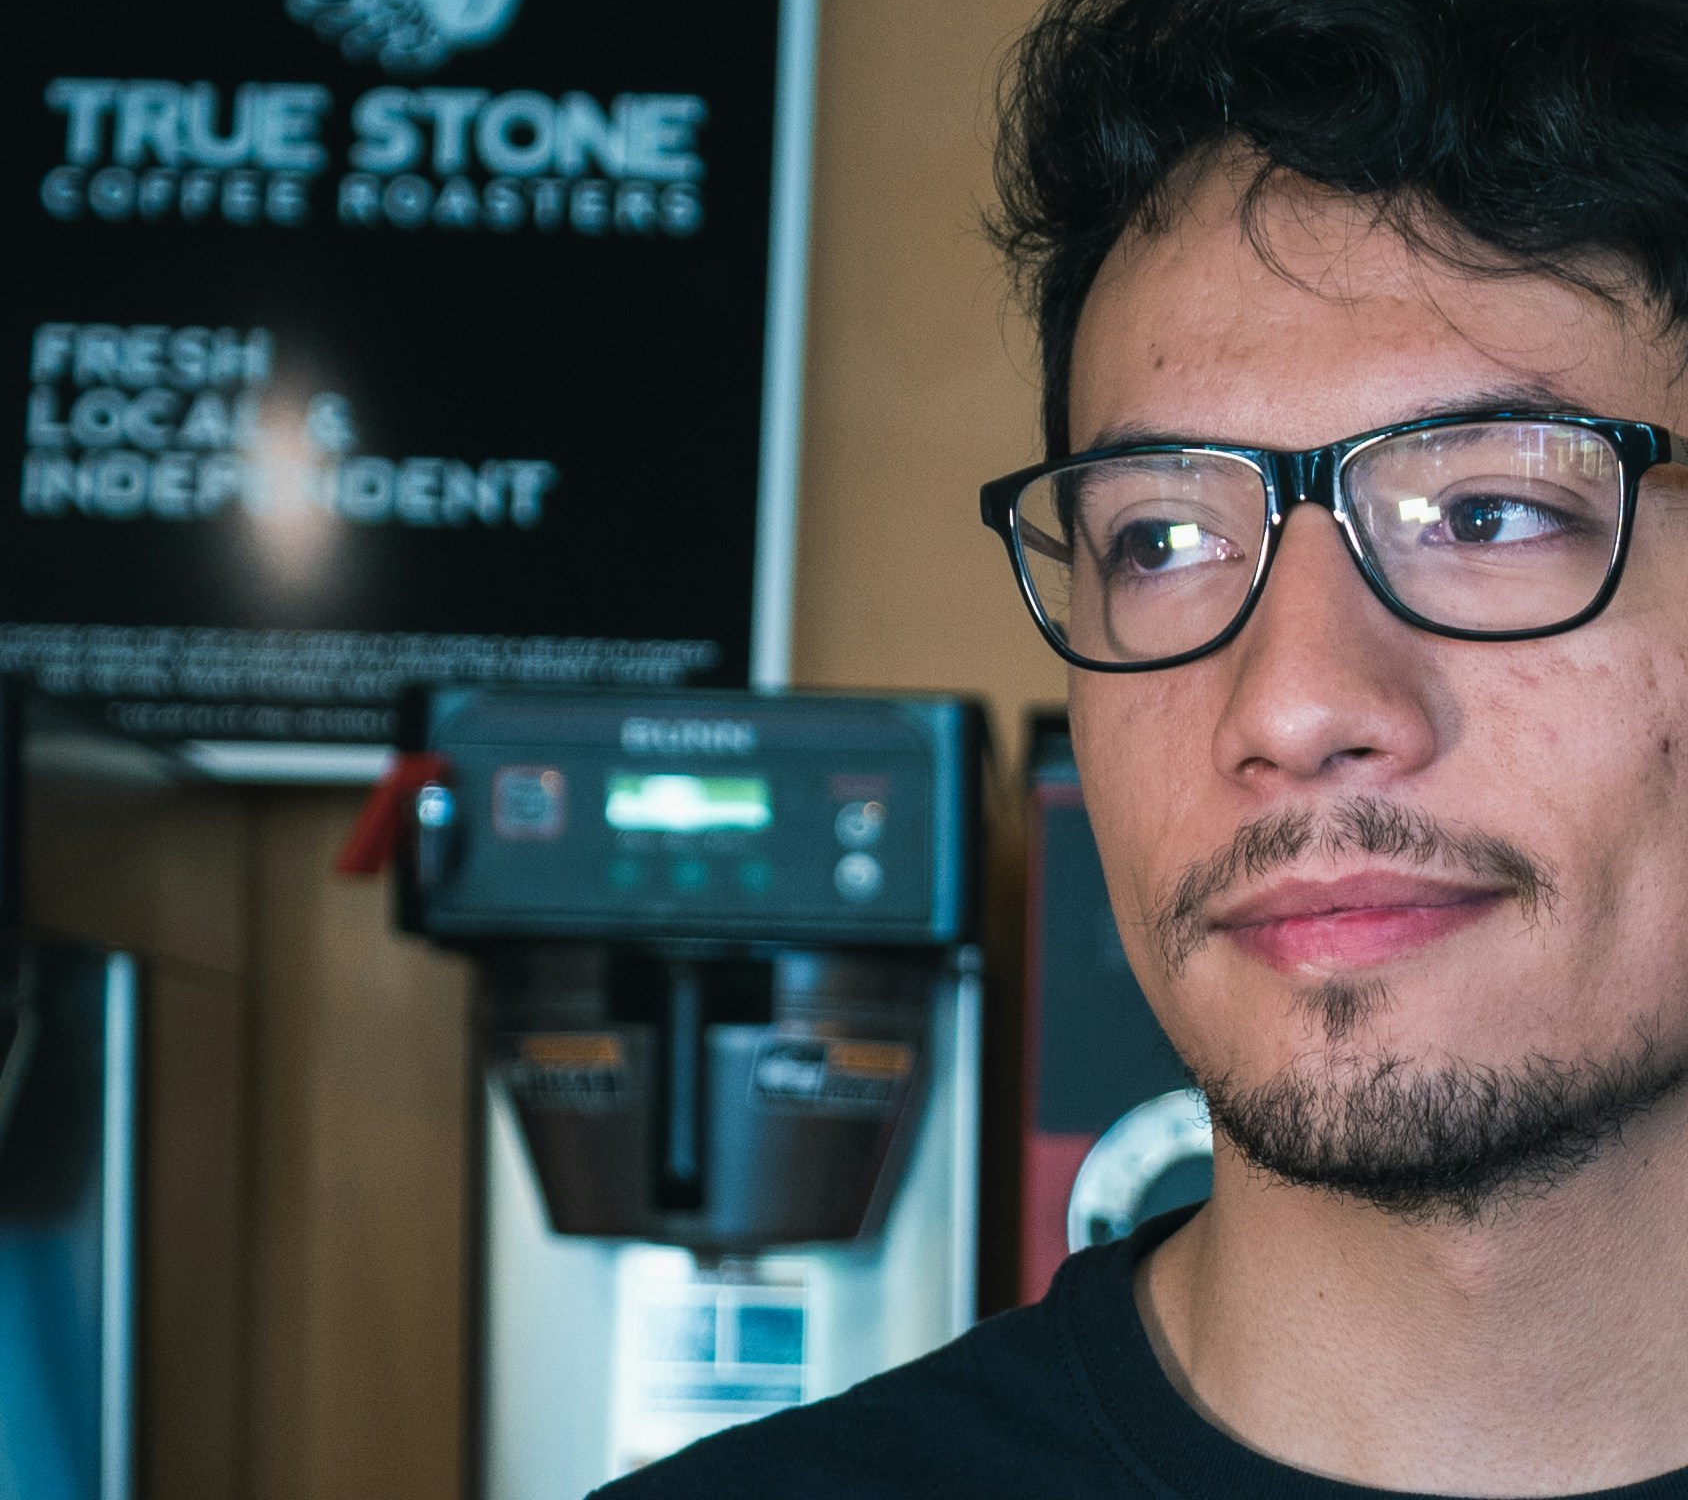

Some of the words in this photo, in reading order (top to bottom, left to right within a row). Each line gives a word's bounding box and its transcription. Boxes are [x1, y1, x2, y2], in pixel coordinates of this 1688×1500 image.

[45, 77, 332, 175] TRUE
[348, 85, 708, 184] STONE
[40, 165, 312, 225] COFFEE
[337, 172, 706, 238] ROASTERS
[30, 322, 273, 389] FRESH
[25, 383, 276, 450] LOCAL
[304, 390, 357, 454] &
[21, 447, 560, 530] INDEPDENT
